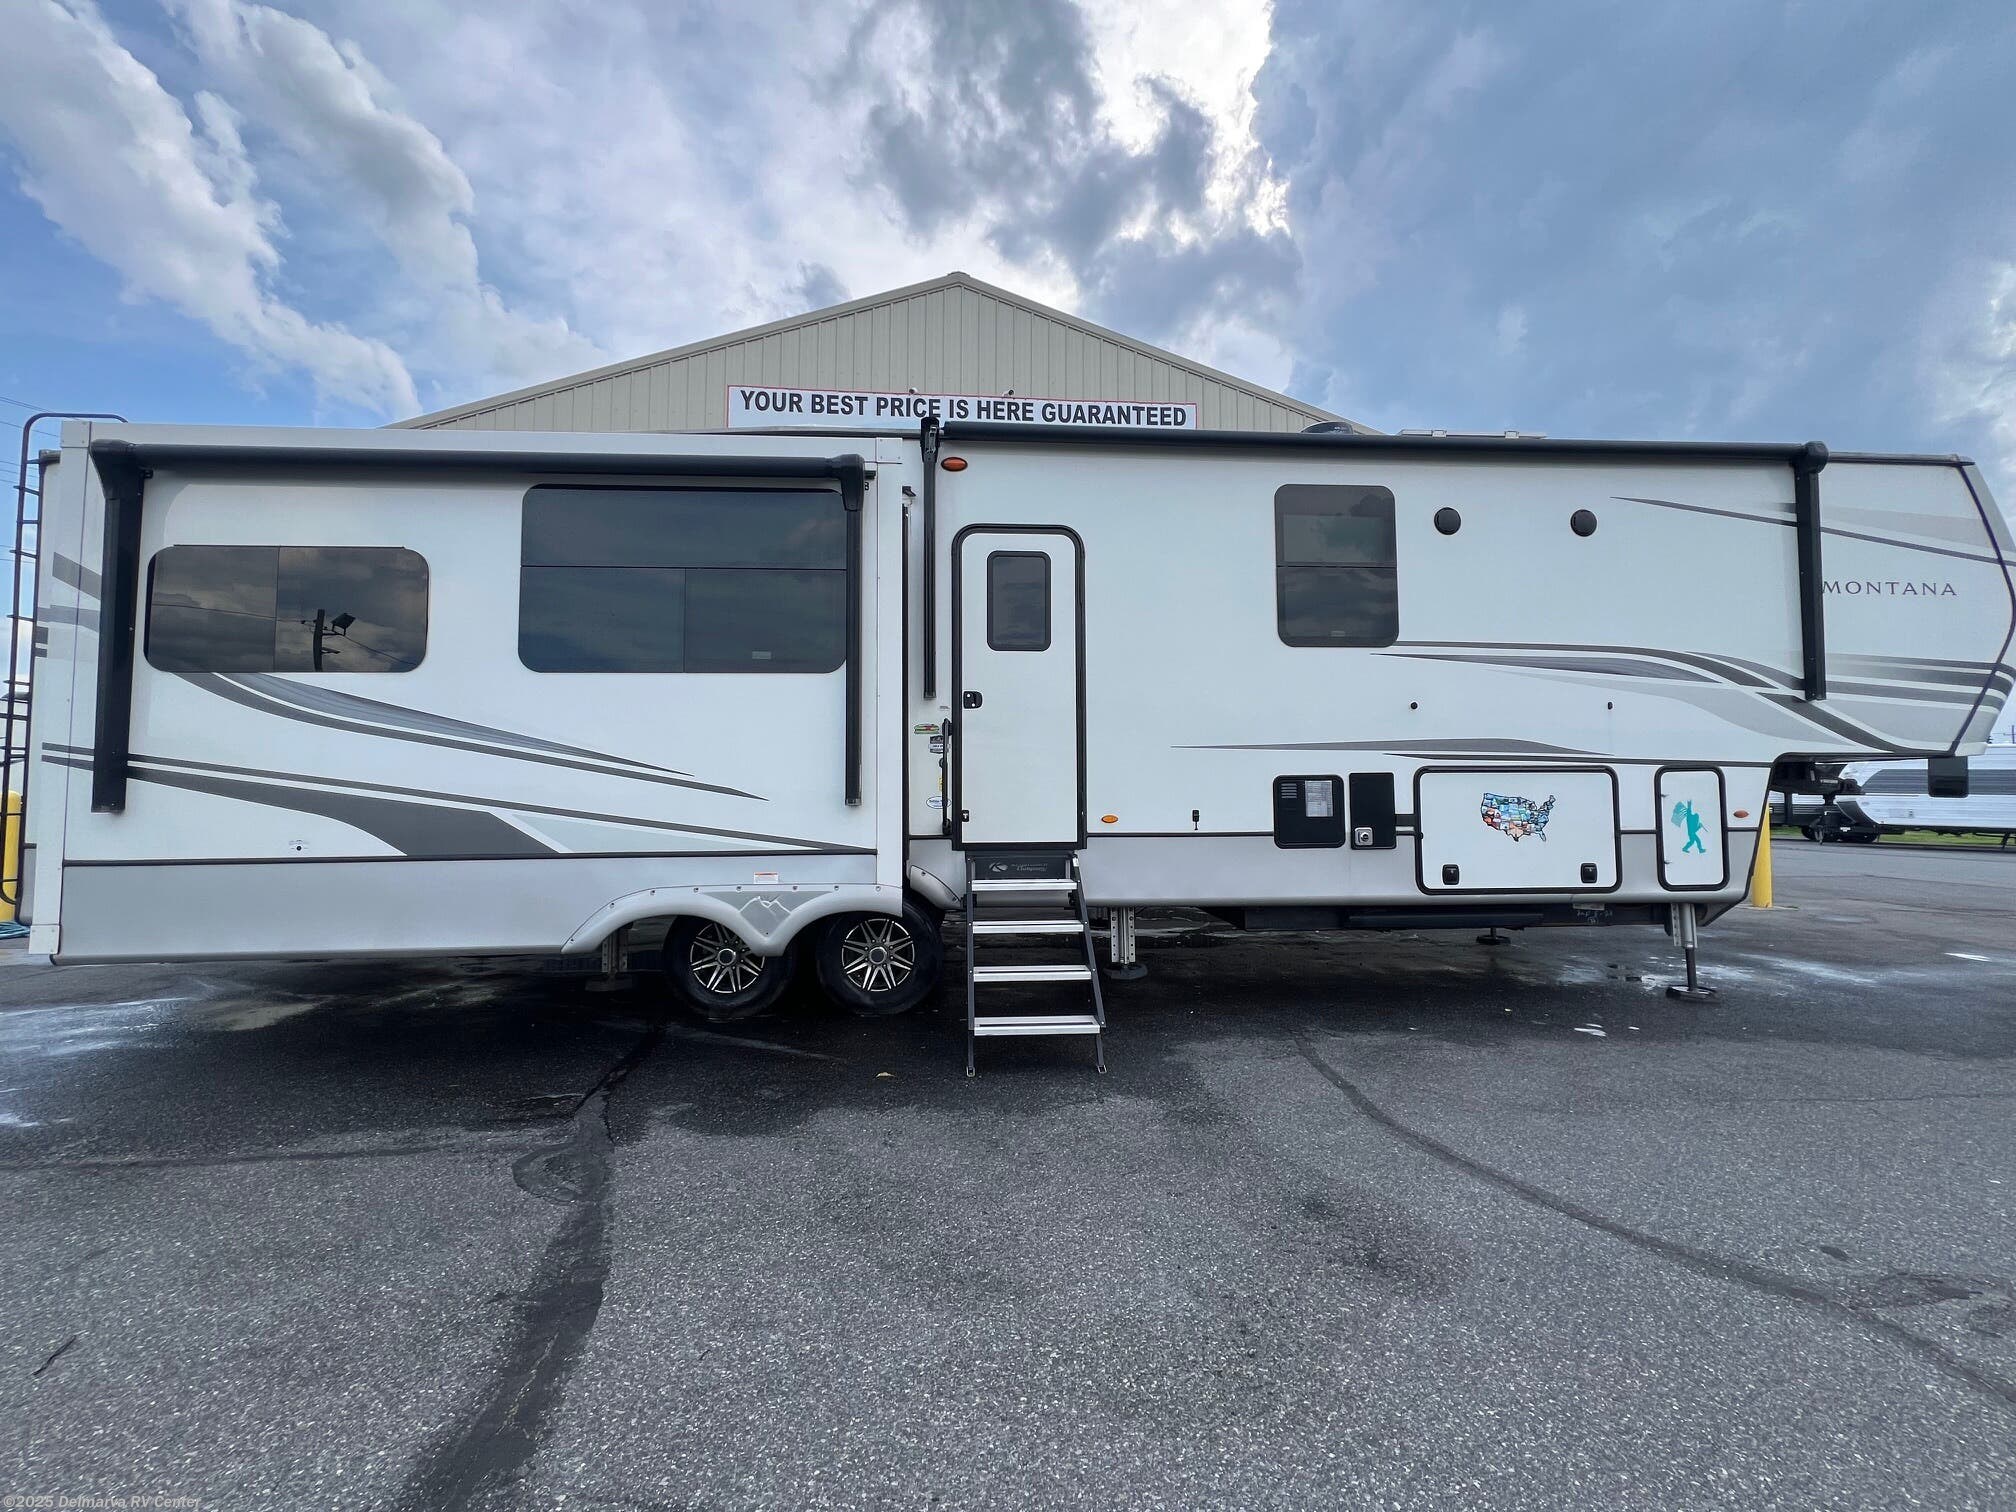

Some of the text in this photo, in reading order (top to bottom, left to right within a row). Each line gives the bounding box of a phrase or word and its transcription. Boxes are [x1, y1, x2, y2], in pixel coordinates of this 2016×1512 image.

[740, 389, 1187, 426] YOUR BEST PRICE IS HERE GUARANTEED
[1822, 580, 1957, 596] MONTANA
